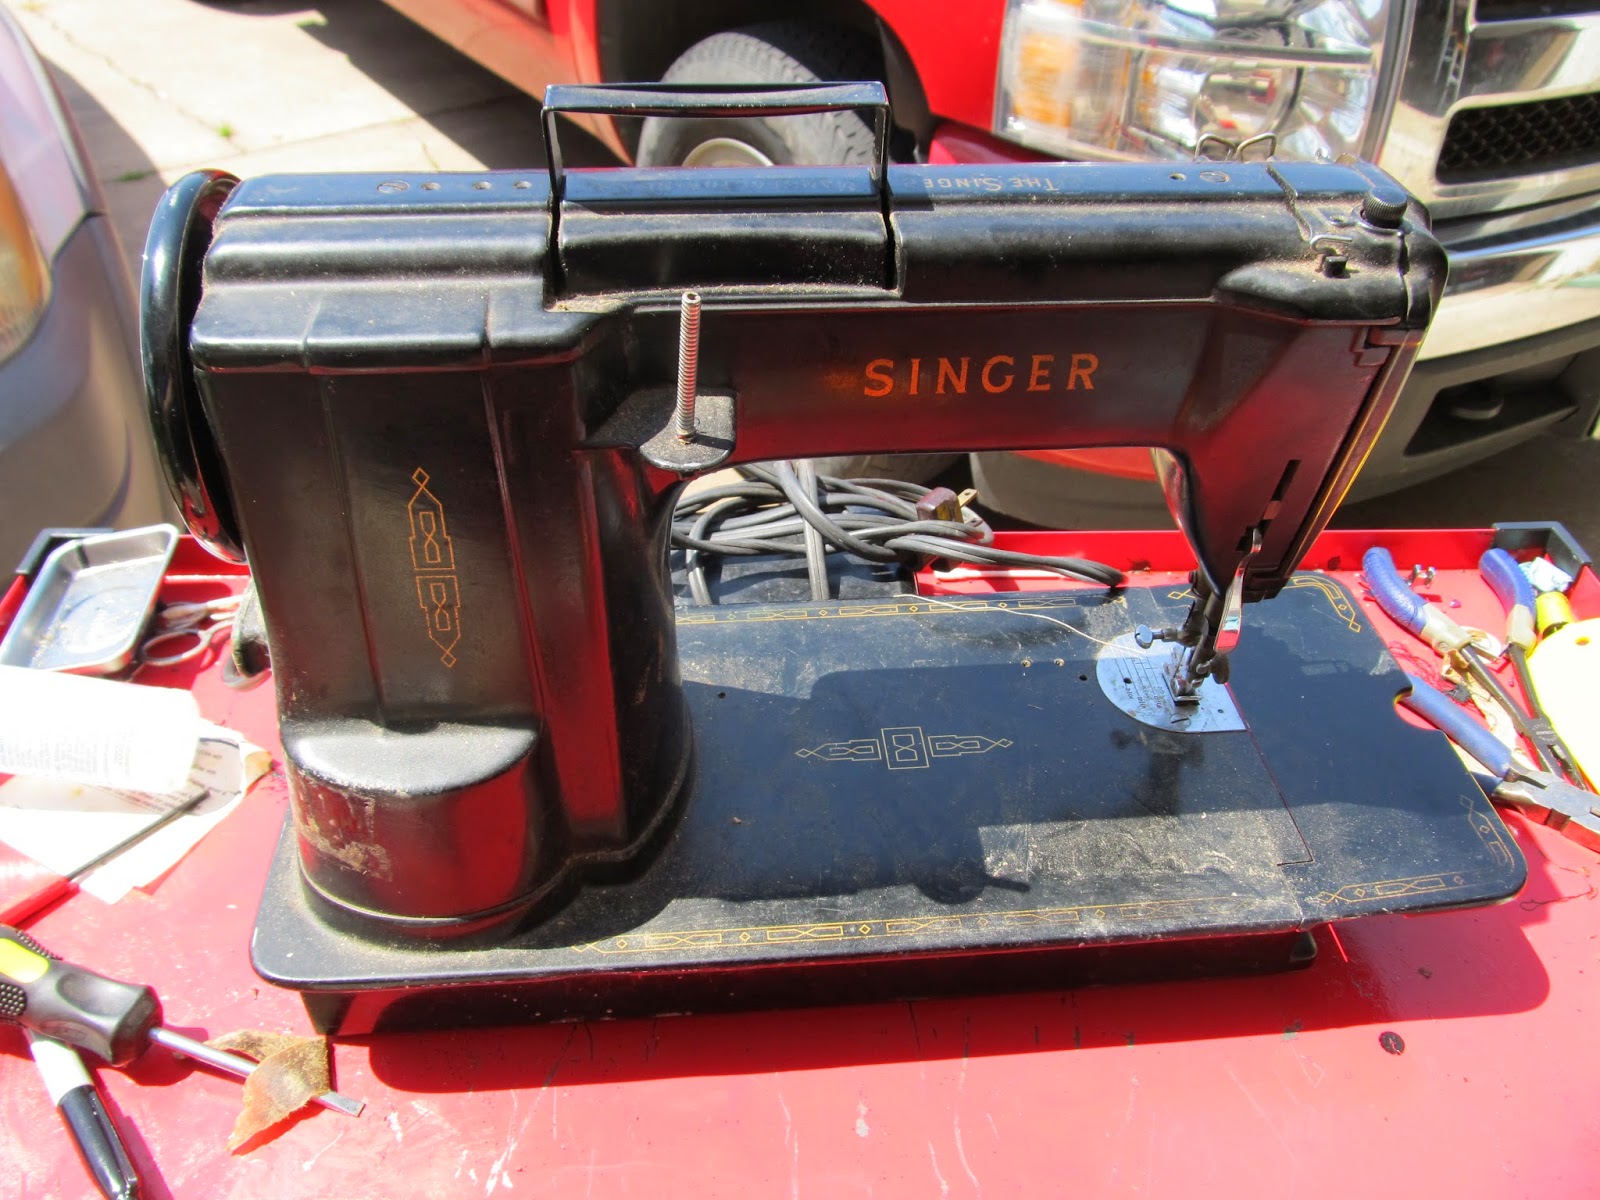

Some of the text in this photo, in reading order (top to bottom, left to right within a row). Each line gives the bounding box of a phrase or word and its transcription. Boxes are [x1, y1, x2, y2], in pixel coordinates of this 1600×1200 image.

[908, 177, 1060, 192] THE SINGE
[864, 353, 1099, 397] SINGER
